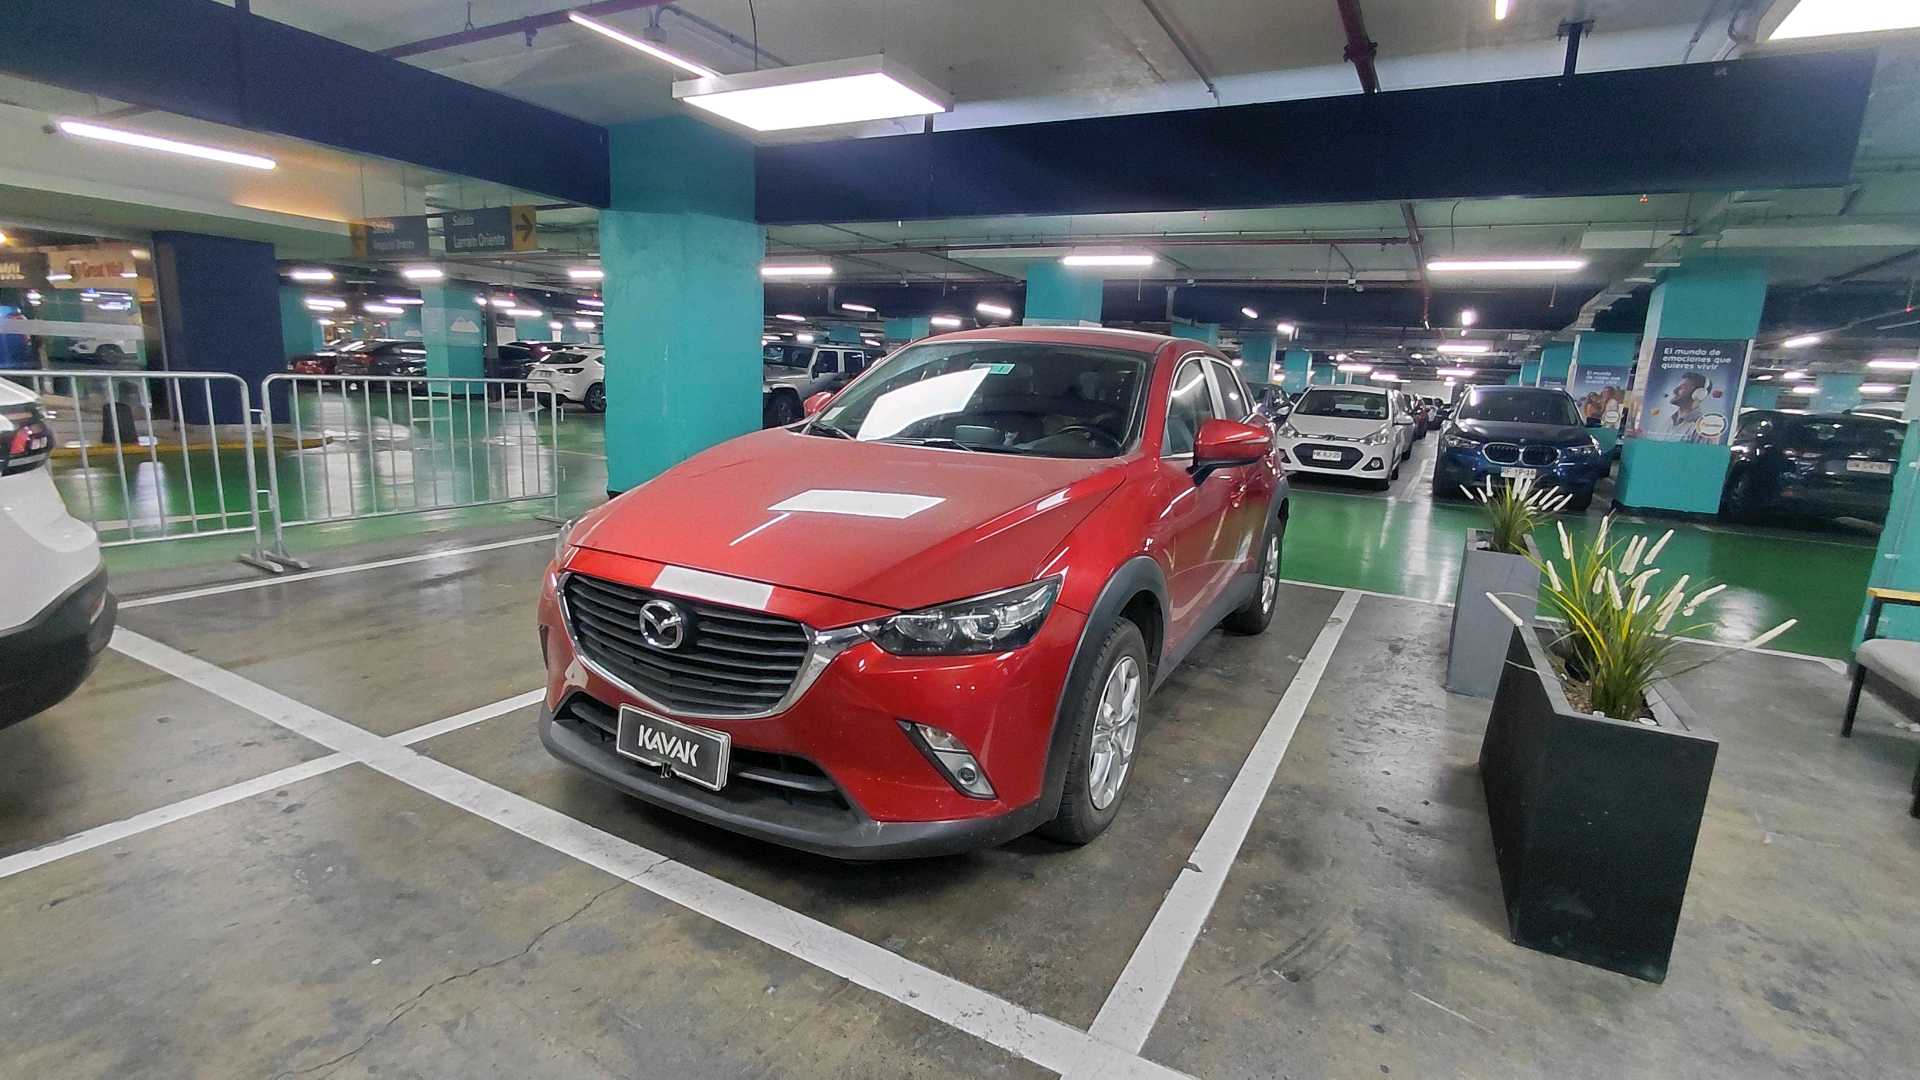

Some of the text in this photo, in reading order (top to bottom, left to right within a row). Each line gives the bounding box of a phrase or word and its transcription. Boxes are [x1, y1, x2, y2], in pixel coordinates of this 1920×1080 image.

[1664, 347, 1673, 355] El
[1708, 348, 1721, 356] de
[1662, 355, 1732, 364] emociones que
[1660, 362, 1719, 370] quieres vivir
[638, 724, 700, 767] KAVAK
